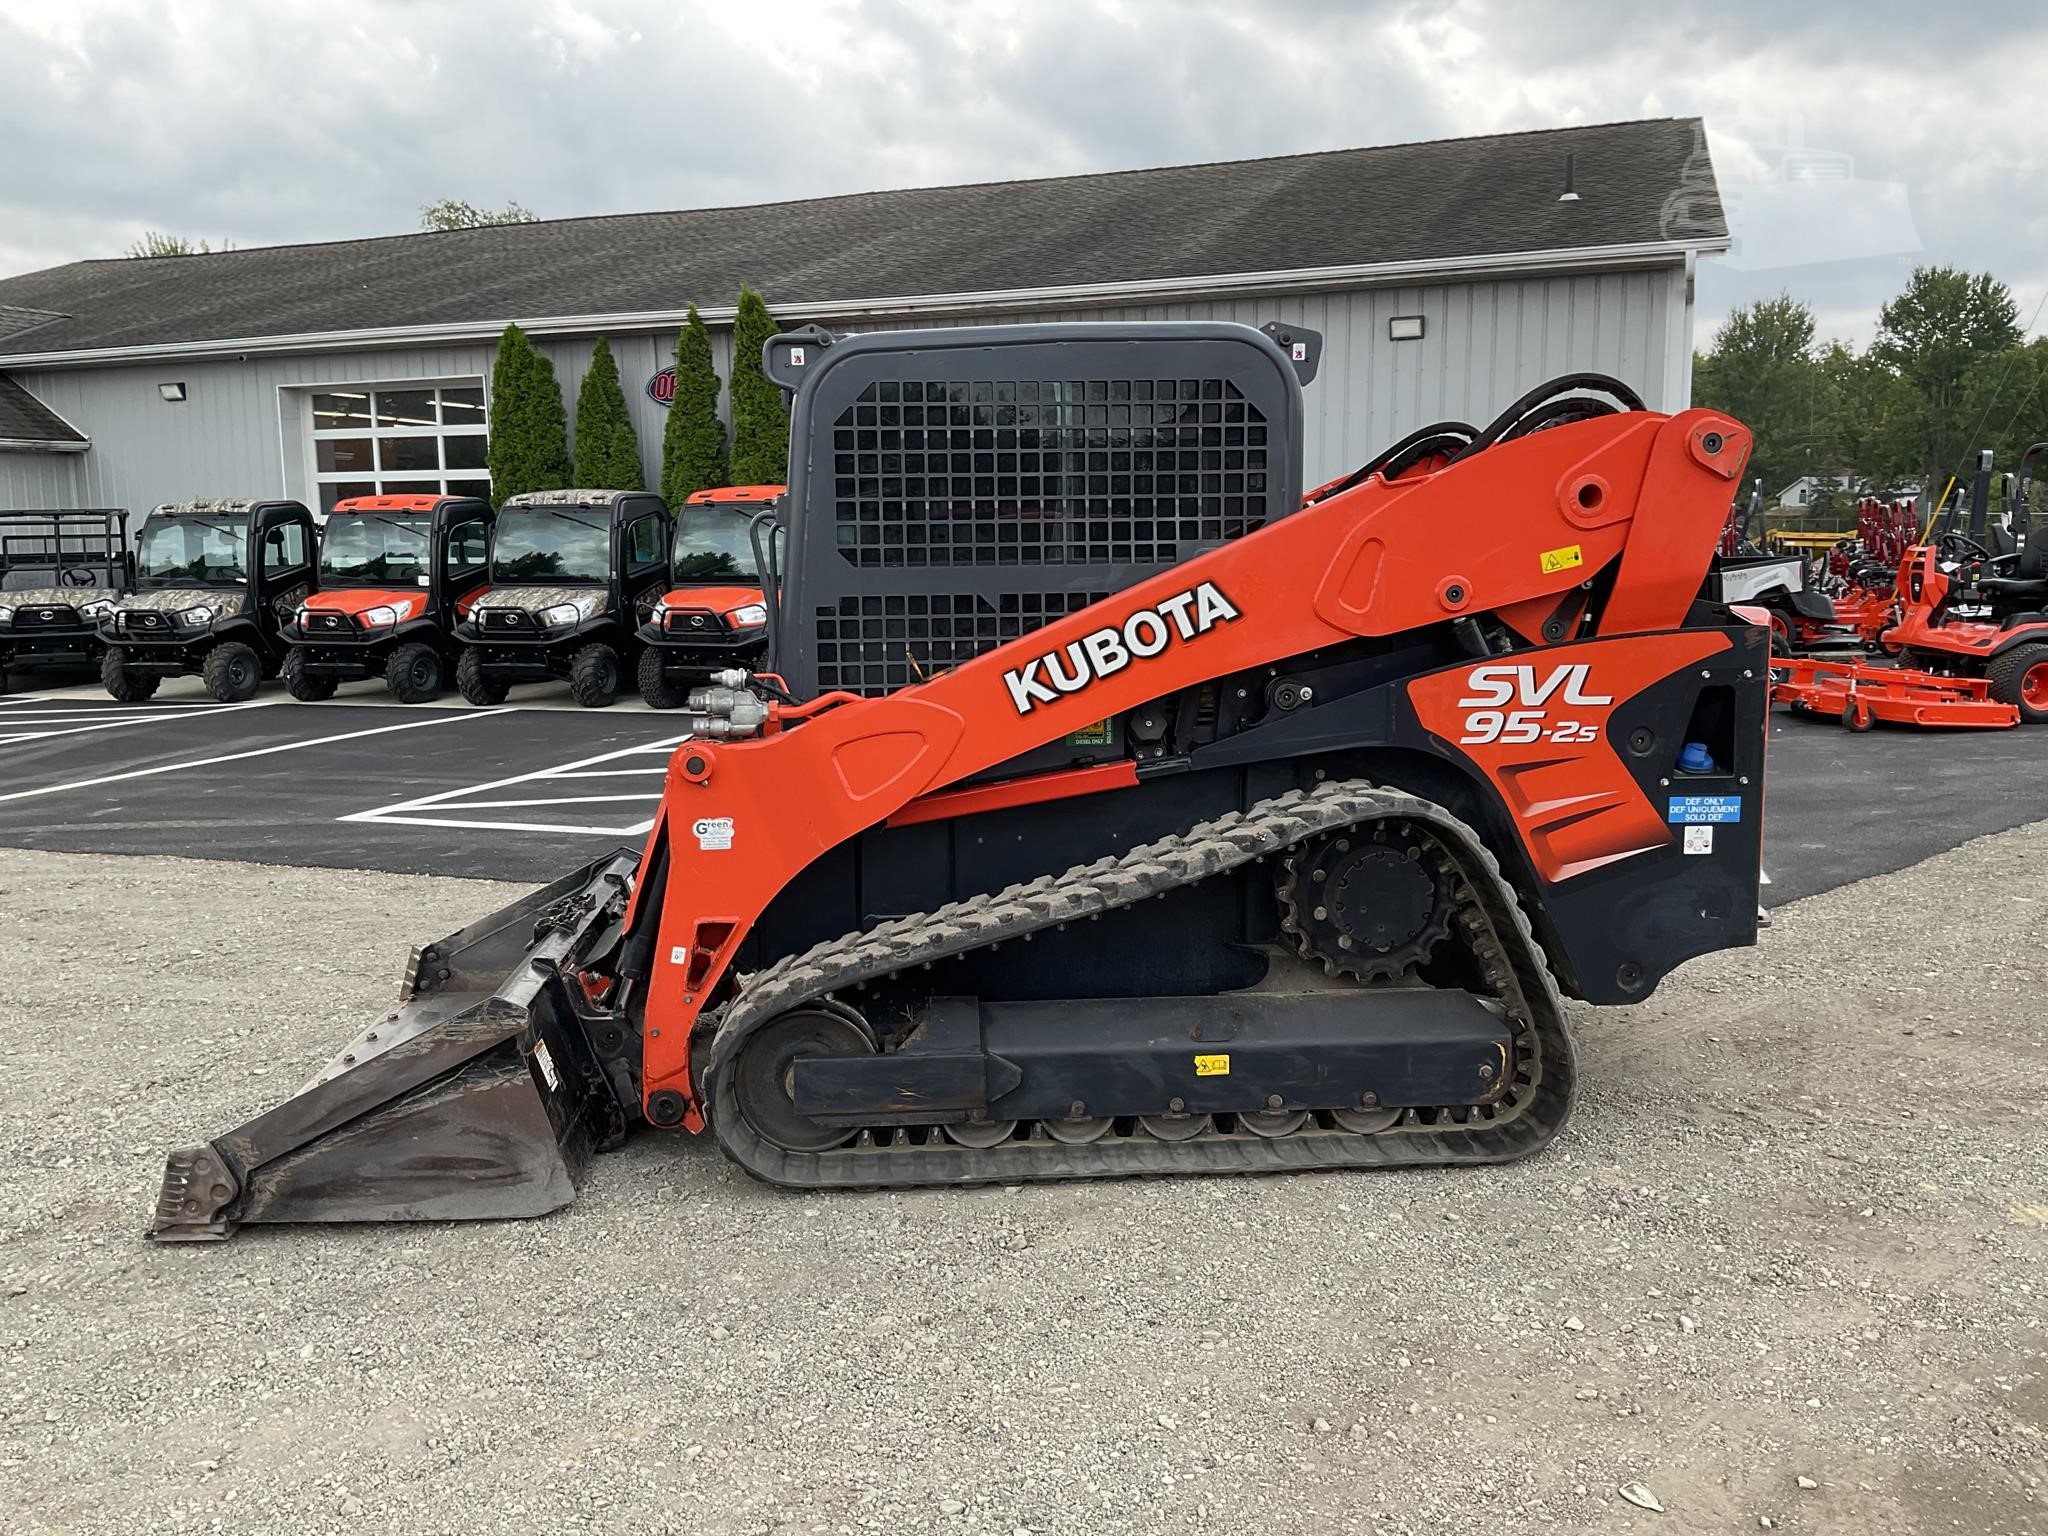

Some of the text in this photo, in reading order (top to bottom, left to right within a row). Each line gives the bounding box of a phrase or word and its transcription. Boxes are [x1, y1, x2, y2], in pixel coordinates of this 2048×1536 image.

[1003, 582, 1241, 715] KUBOTA
[1457, 664, 1616, 708] SVL
[1685, 798, 1701, 806] DEF
[1669, 806, 1686, 814] DEF
[1708, 813, 1724, 821] DEF
[696, 821, 729, 835] Green
